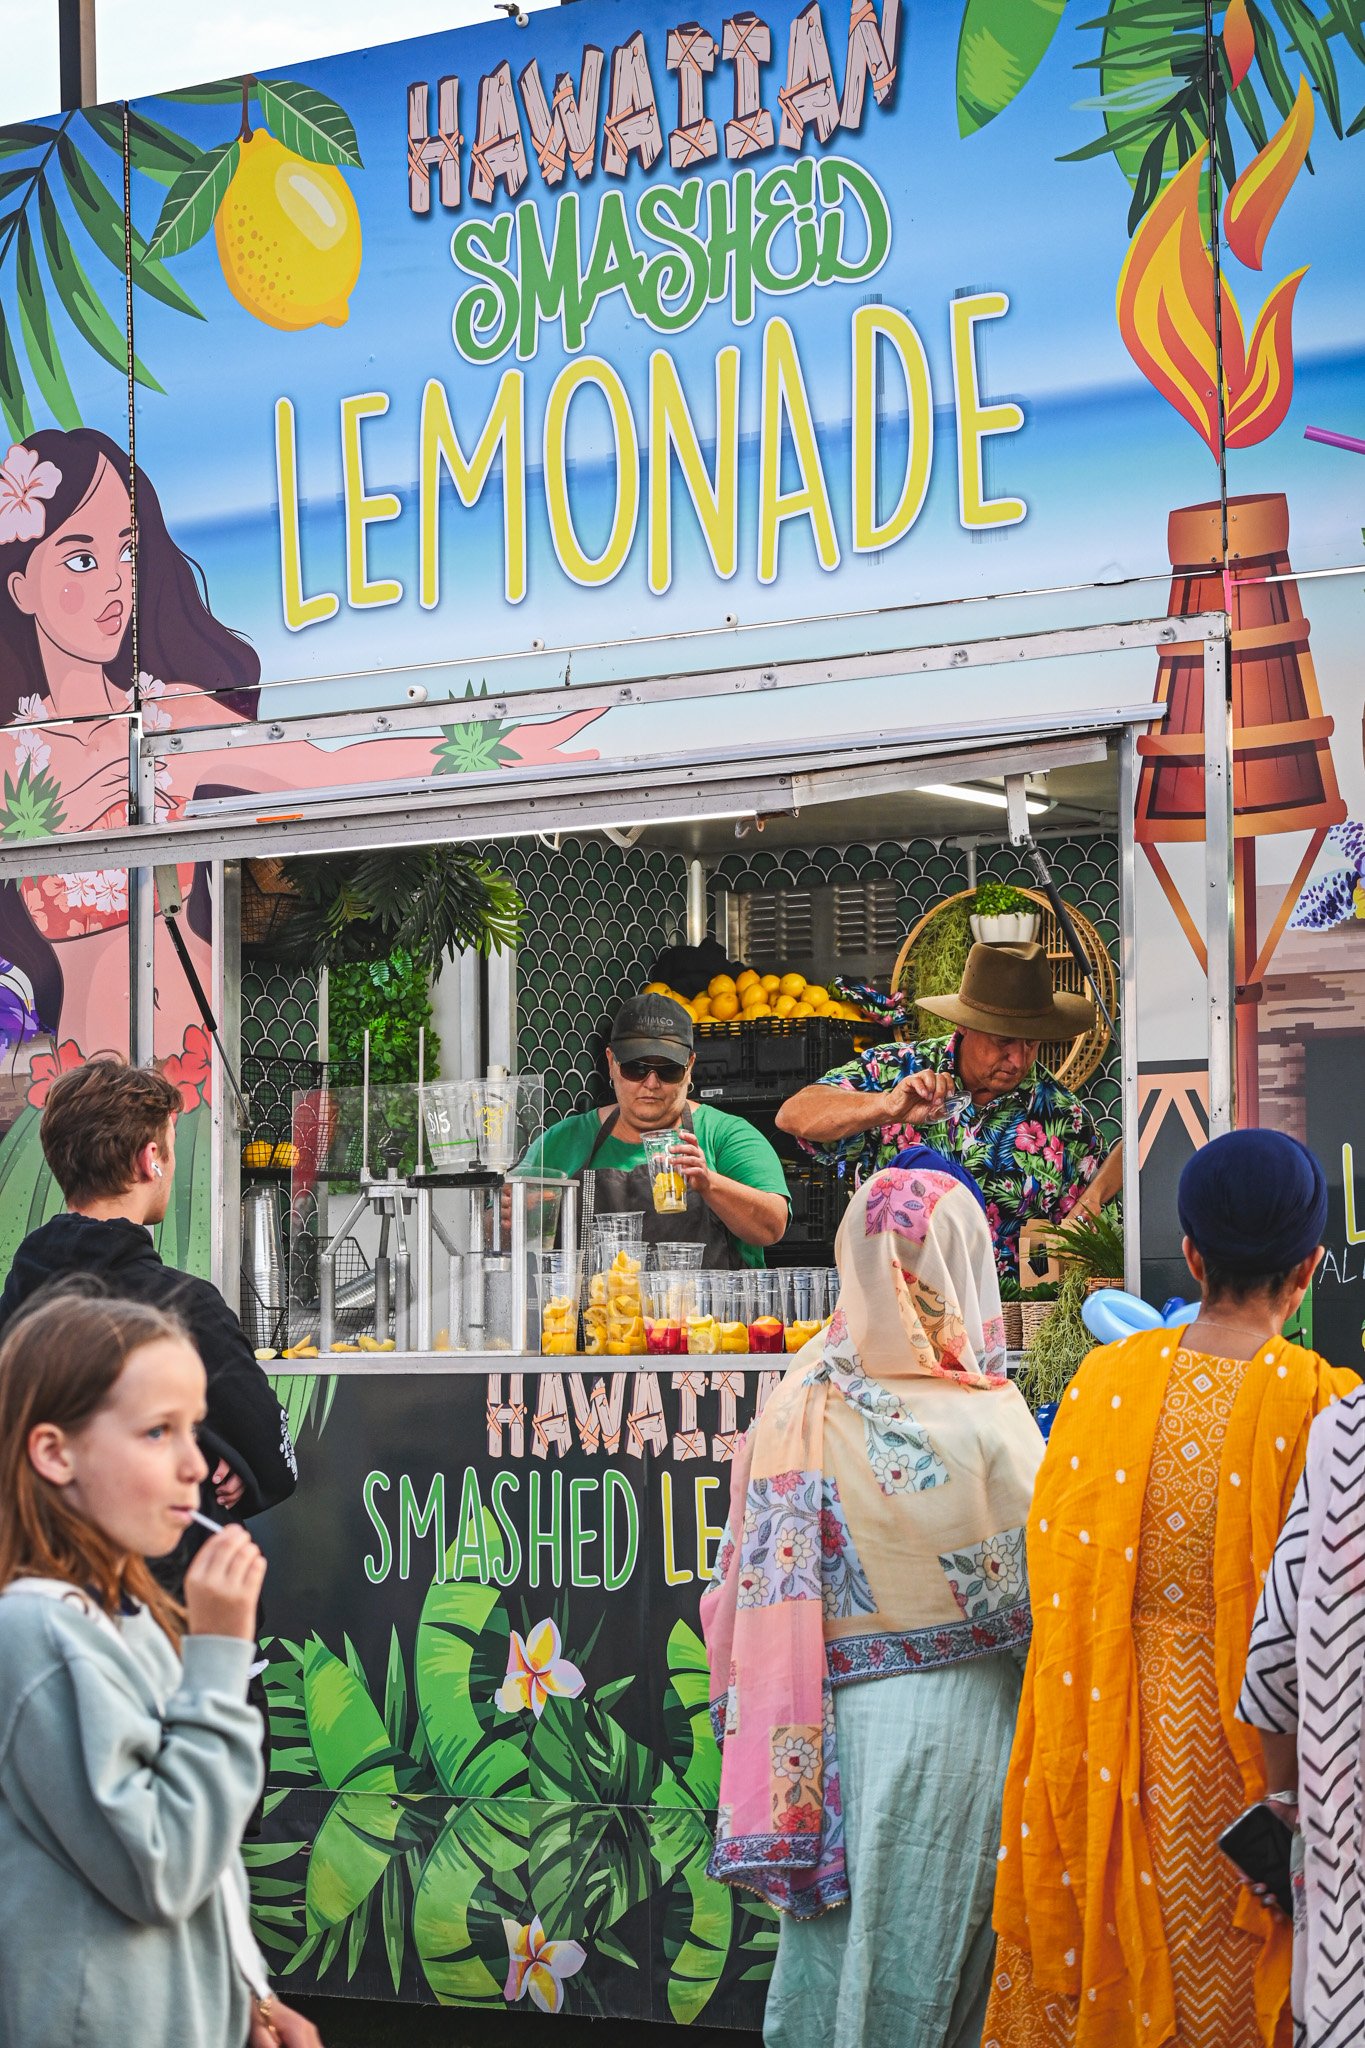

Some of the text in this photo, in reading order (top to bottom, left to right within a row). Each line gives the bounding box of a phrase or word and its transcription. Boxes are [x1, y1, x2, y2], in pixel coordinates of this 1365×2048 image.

[407, 0, 901, 213] HAWAIIAN
[451, 155, 892, 365] SMASHED
[273, 291, 1027, 632] LEMONADE
[638, 1015, 674, 1027] MIMCO
[427, 1110, 451, 1134] $15
[362, 1466, 640, 1592] SMASHED
